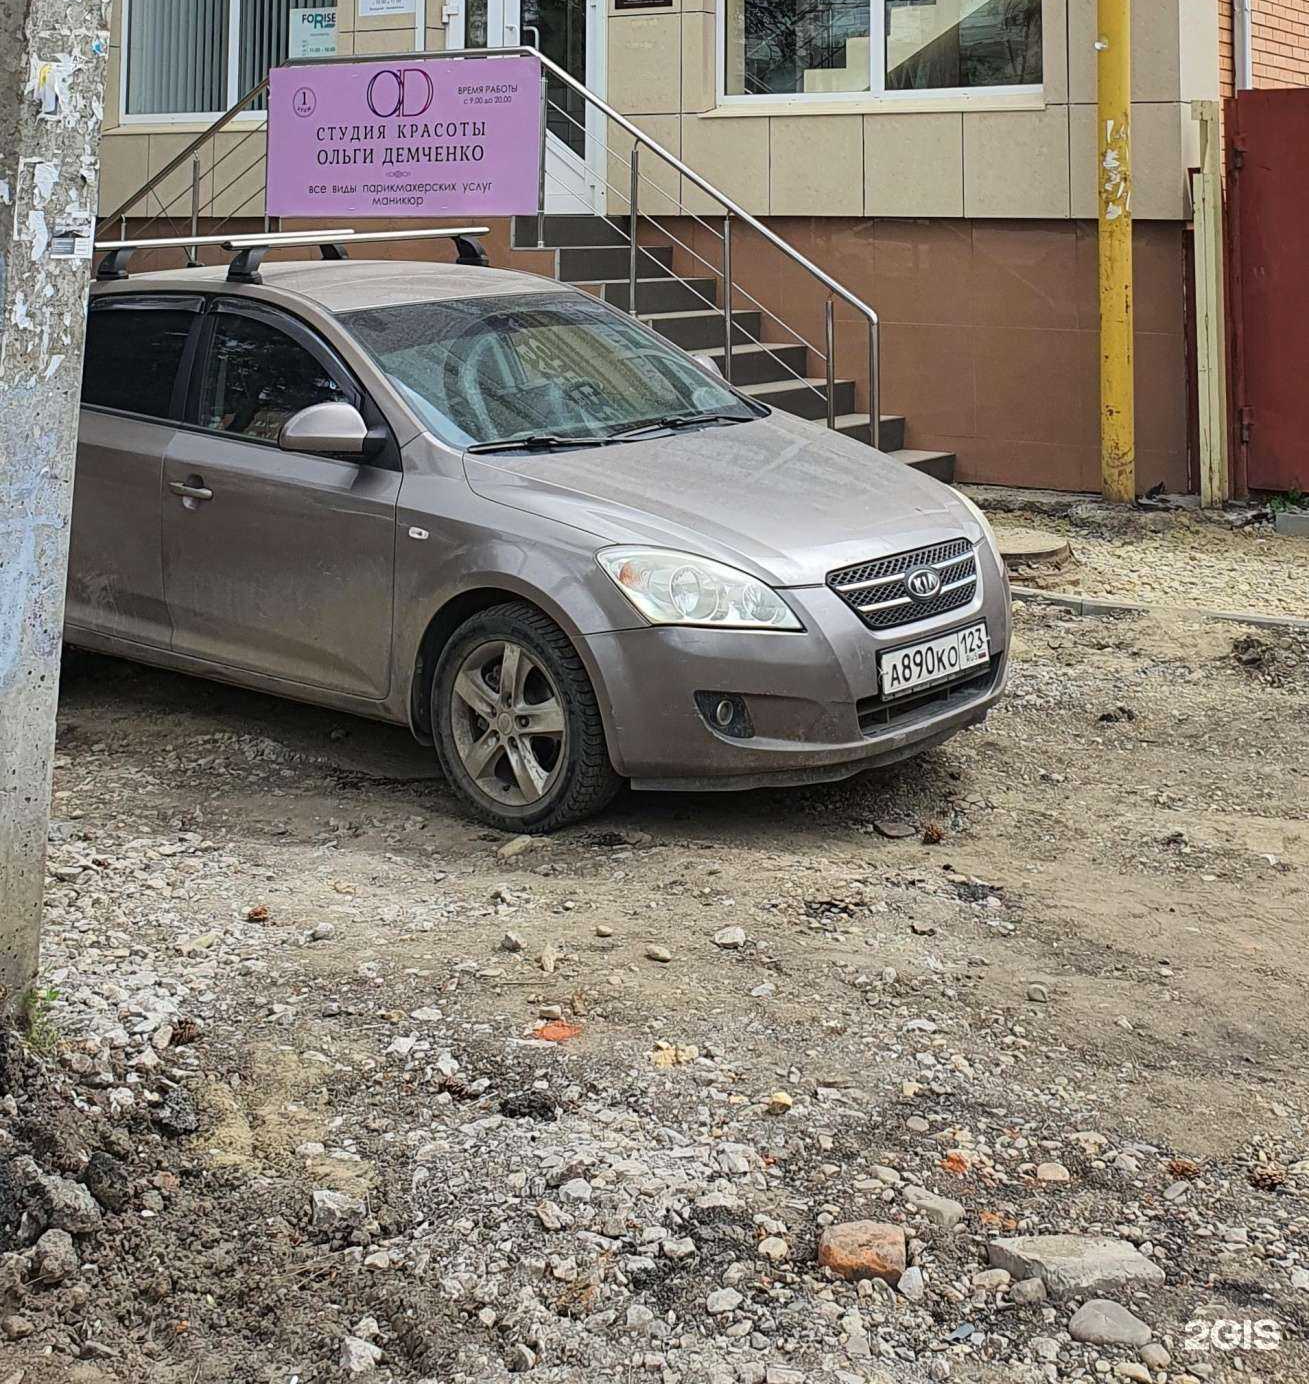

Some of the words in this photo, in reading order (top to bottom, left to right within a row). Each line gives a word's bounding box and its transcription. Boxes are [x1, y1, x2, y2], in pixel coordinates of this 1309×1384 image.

[302, 13, 336, 29] FORISE
[458, 85, 484, 95] ВРЕМЯ
[485, 84, 518, 94] РАБОТЫ
[302, 91, 308, 105] 1
[316, 125, 386, 144] СТУДИЯ
[398, 121, 486, 140] КРАСОТЫ
[317, 149, 374, 165] ОЛЬГИ
[382, 144, 484, 165] ДЕМЧЕНКО
[309, 185, 326, 193] все
[332, 183, 357, 194] виды
[362, 181, 456, 196] парикмахерских
[463, 181, 492, 195] услуг
[372, 195, 424, 208] маникюр
[912, 574, 938, 593] KIA
[891, 646, 958, 687] А890КО
[961, 628, 985, 654] 123
